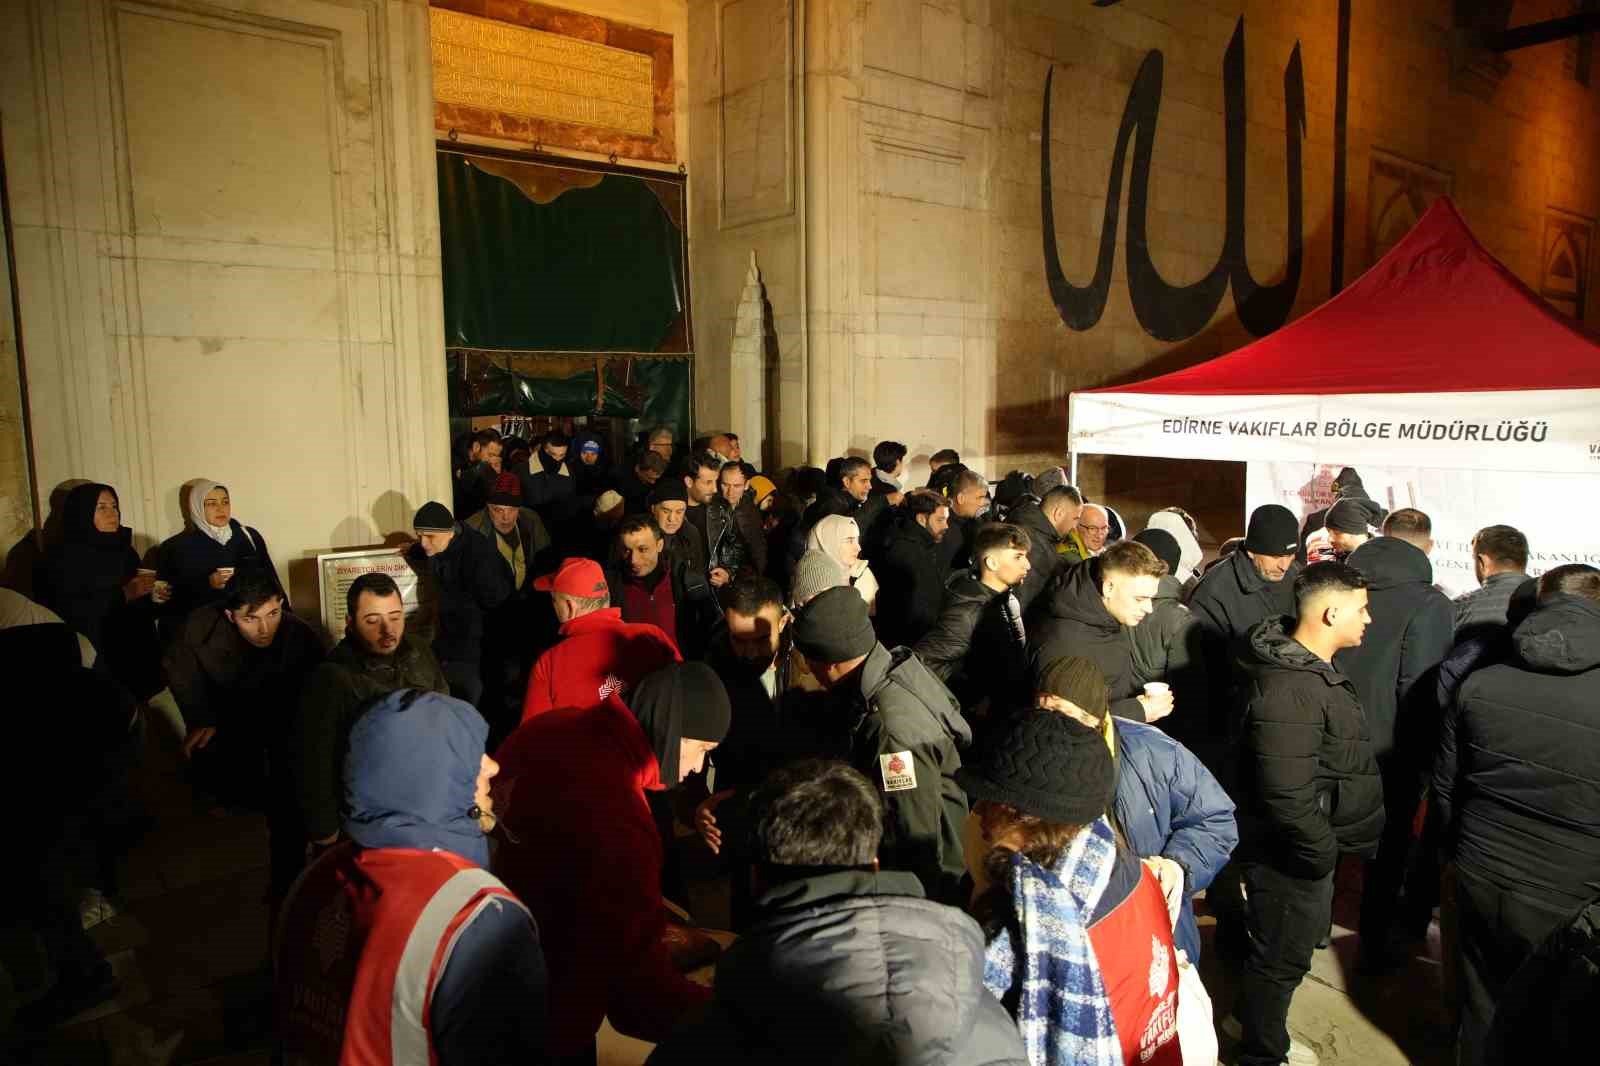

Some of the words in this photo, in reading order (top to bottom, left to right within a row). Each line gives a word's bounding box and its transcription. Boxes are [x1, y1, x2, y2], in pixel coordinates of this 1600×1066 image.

[1162, 417, 1224, 435] EDİRNE
[1228, 421, 1318, 437] VAKIFLAR
[1324, 419, 1392, 439] BÖLGE
[1398, 420, 1549, 442] MÜDÜRLÜĞÜ
[1435, 559, 1473, 570] GENE
